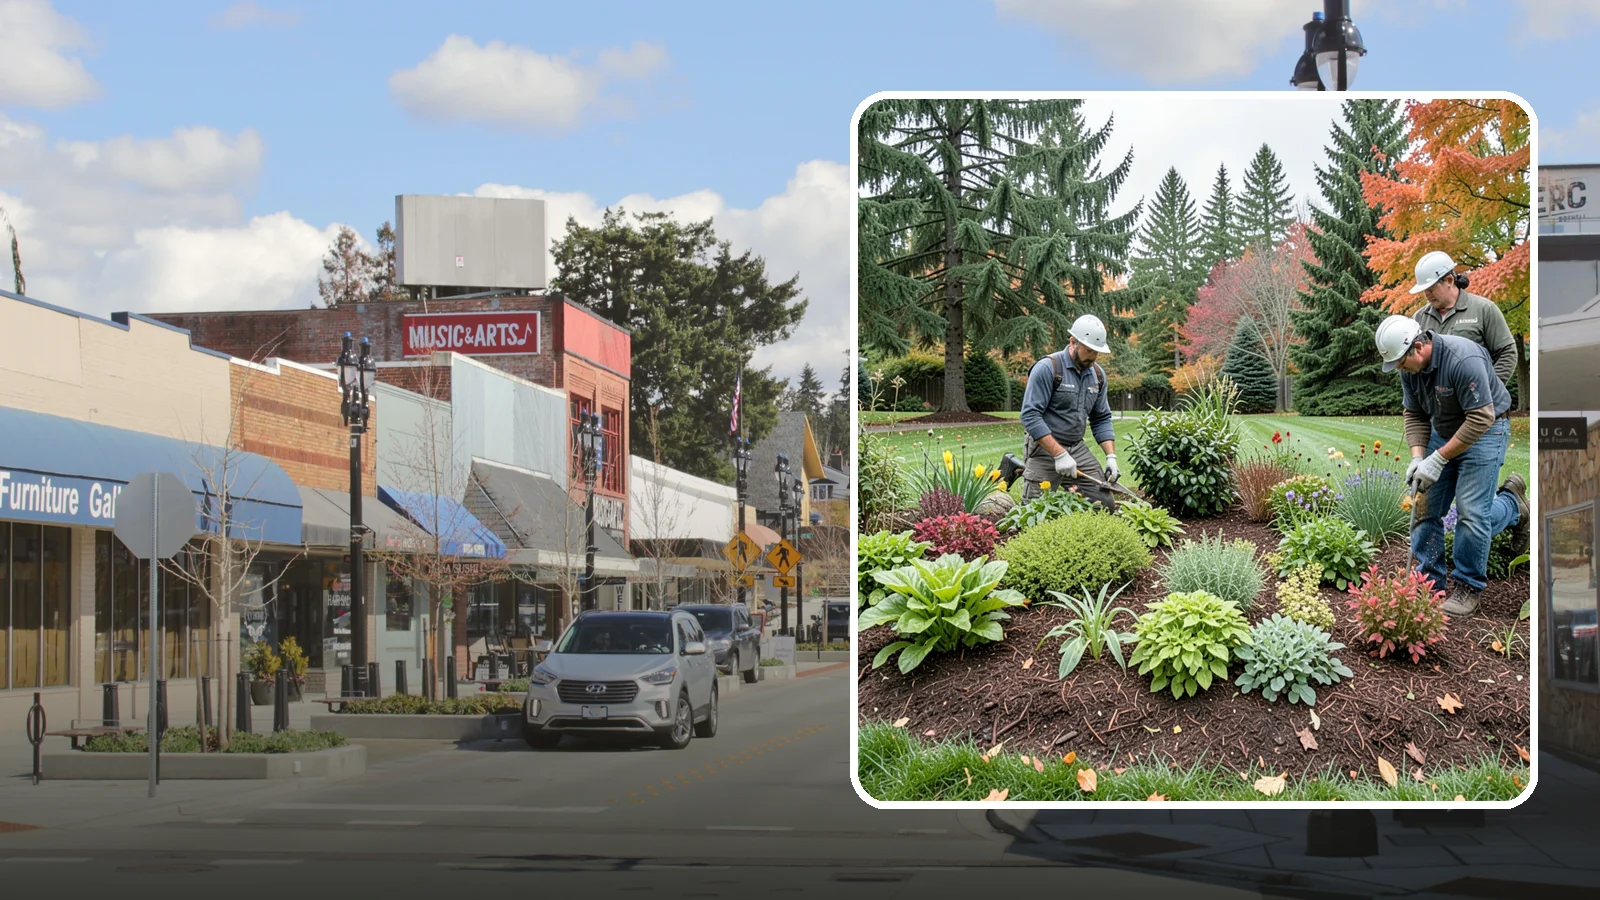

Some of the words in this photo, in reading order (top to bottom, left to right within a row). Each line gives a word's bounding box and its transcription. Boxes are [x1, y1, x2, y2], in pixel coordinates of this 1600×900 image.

[1538, 181, 1586, 213] ERC
[1541, 428, 1577, 436] UGA
[0, 472, 79, 515] Furniture
[89, 482, 121, 519] Gal
[453, 563, 480, 574] SUSHI
